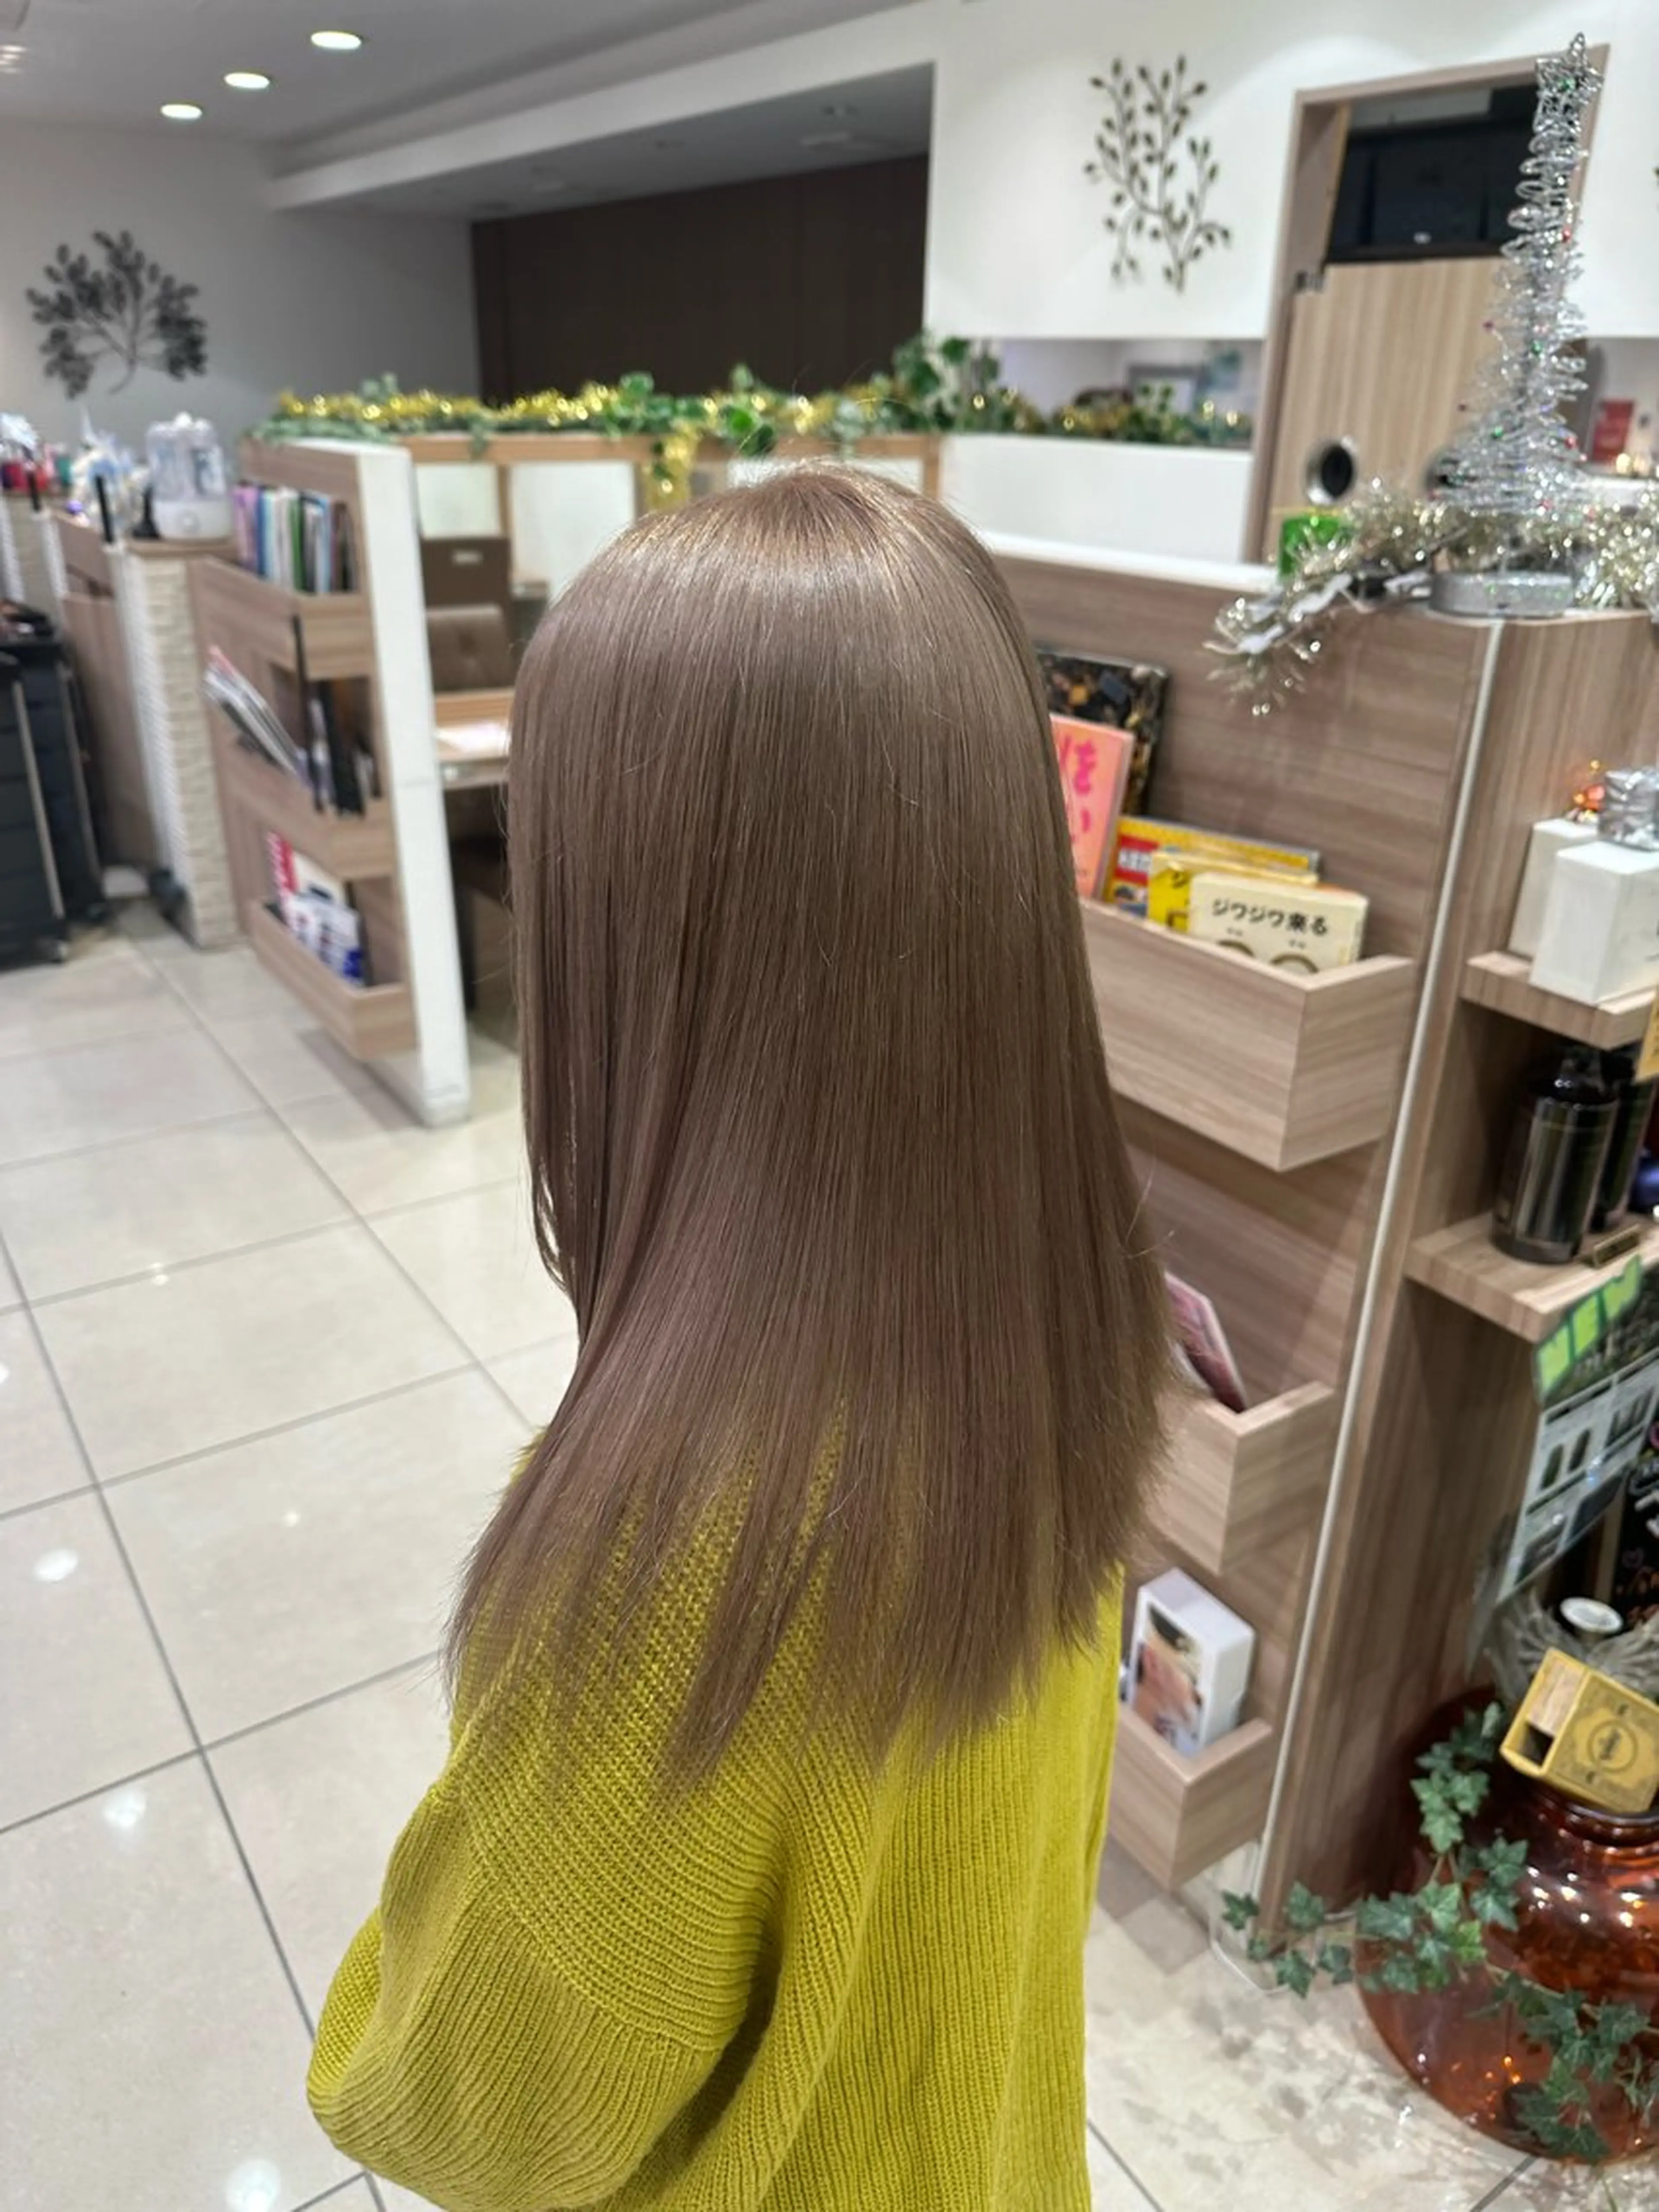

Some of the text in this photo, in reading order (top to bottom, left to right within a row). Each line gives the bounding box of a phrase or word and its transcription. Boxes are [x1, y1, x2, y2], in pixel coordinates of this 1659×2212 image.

[1212, 899, 1328, 936] ジワジワ来る
